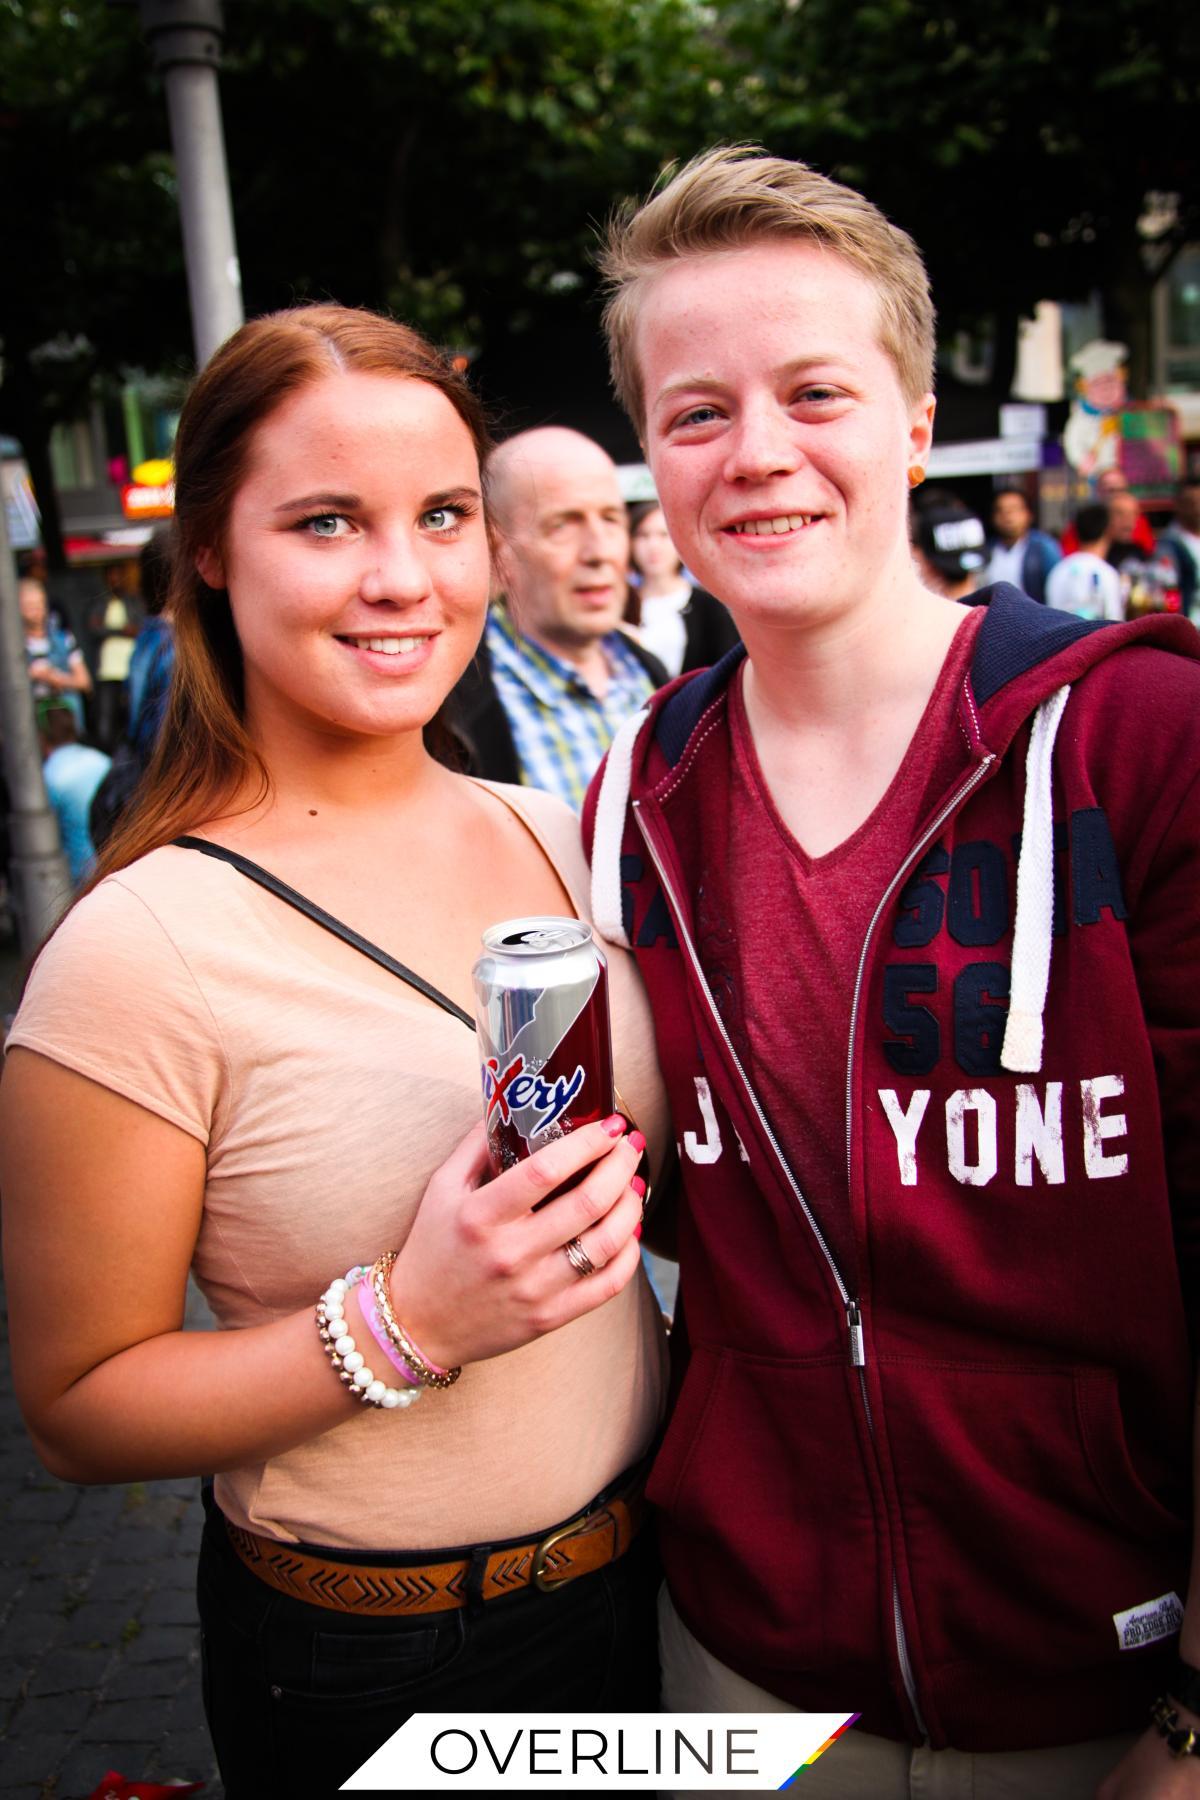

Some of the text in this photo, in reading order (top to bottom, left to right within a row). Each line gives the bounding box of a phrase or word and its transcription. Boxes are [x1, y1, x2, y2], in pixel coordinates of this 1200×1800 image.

[882, 961, 1011, 1077] 56
[481, 1054, 585, 1139] ixery
[877, 1075, 1129, 1186] YONE
